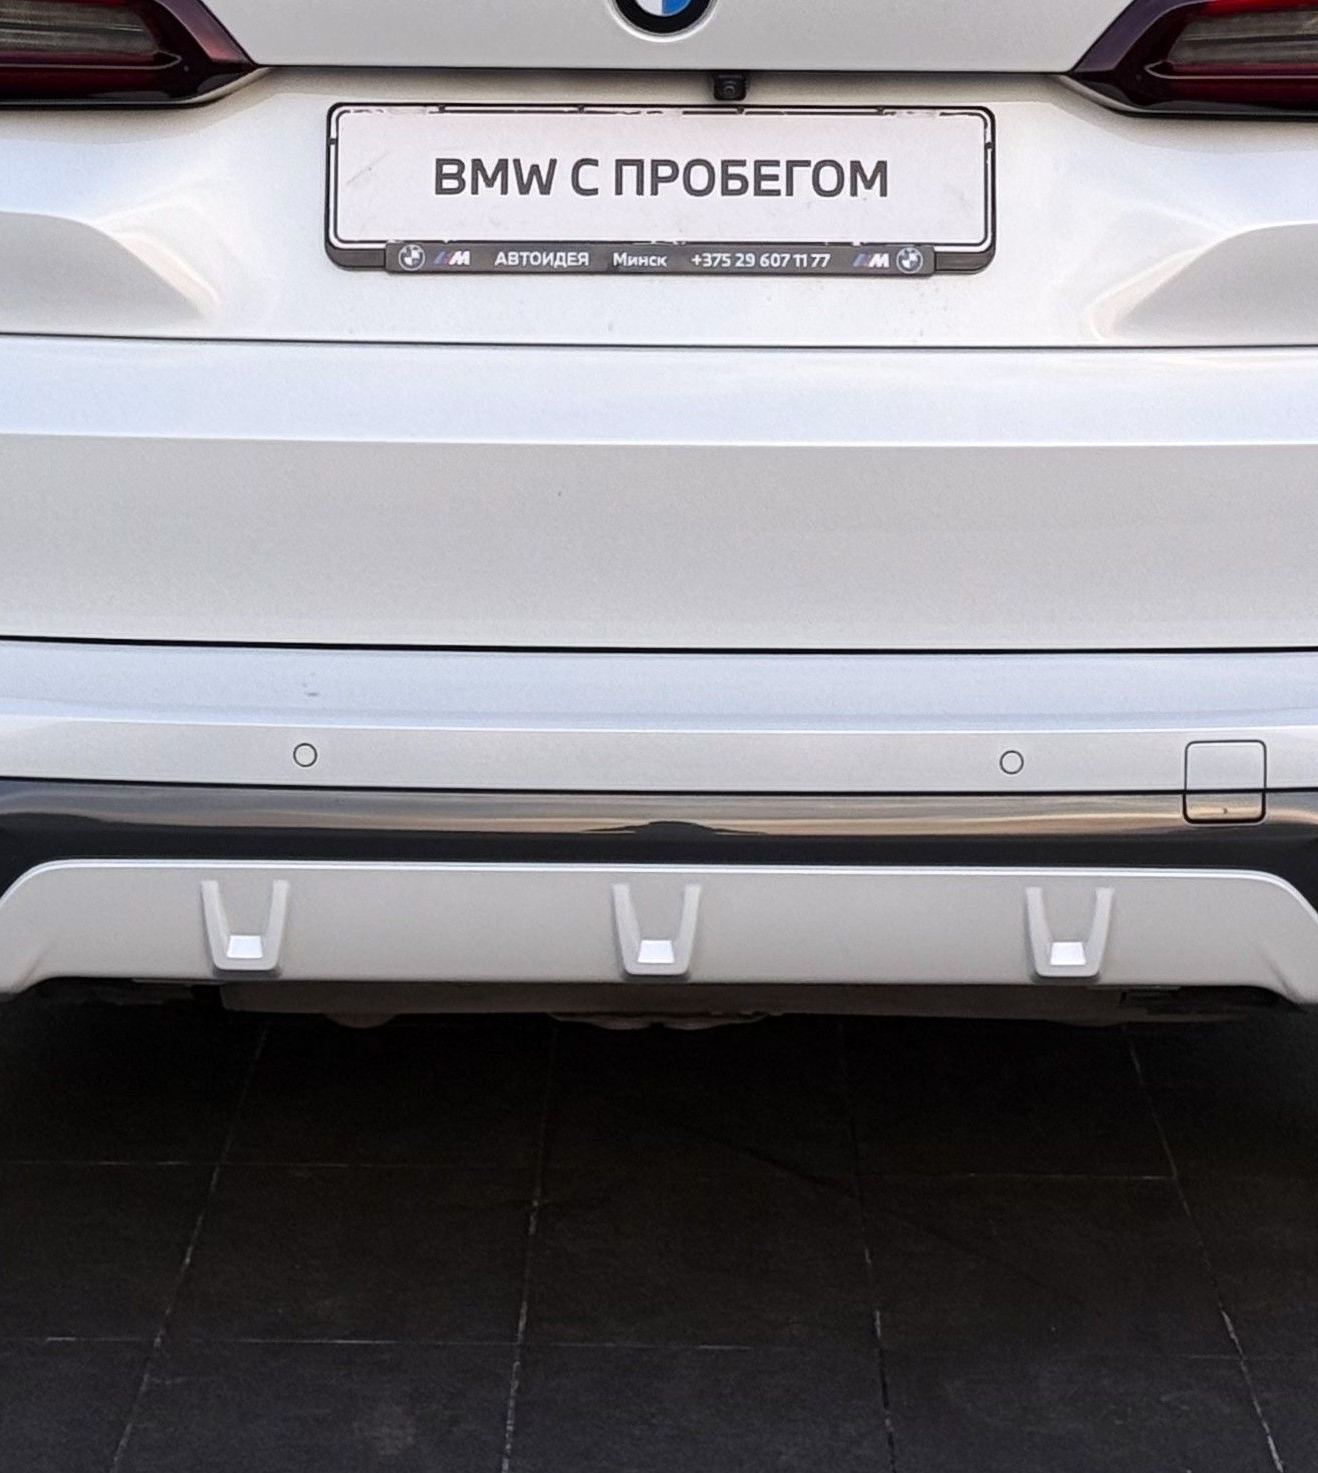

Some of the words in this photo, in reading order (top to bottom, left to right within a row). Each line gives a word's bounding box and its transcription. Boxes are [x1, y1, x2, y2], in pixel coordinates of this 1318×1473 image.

[435, 158, 557, 196] BMW
[571, 158, 599, 196] С
[614, 158, 888, 198] ПРОБЕГОМ
[494, 251, 590, 268] АВТОИДЕЯ
[613, 252, 668, 267] Минск
[691, 253, 731, 268] +375
[735, 253, 756, 268] 29
[759, 253, 790, 268] 607
[793, 253, 808, 268] 11
[811, 253, 831, 268] 77
